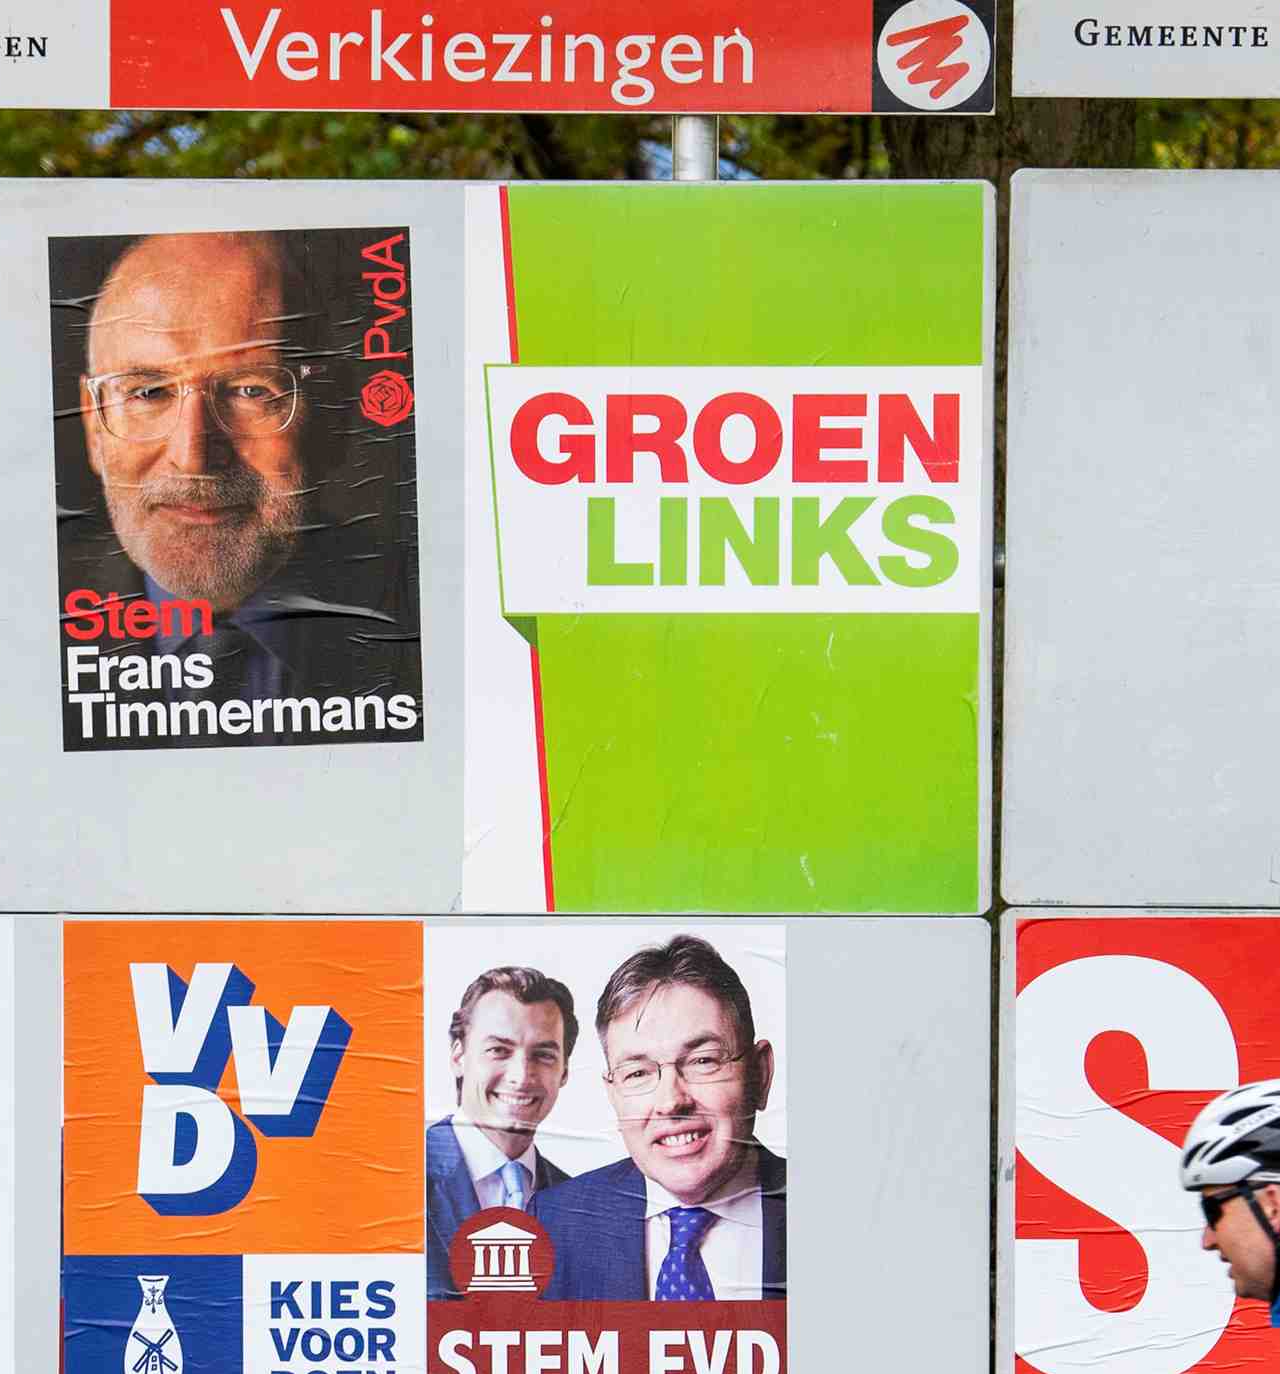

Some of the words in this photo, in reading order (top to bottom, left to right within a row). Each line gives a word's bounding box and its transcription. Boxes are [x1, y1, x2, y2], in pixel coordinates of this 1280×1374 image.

[220, 7, 756, 105] Verkiezingen
[362, 232, 408, 361] PvdA
[509, 391, 961, 485] GROEN
[586, 494, 960, 588] LINKS
[63, 588, 215, 641] Stem
[65, 646, 215, 691] Frans
[67, 691, 418, 739] Timmermans
[270, 1279, 397, 1320] KIES
[270, 1327, 397, 1364] VOOR
